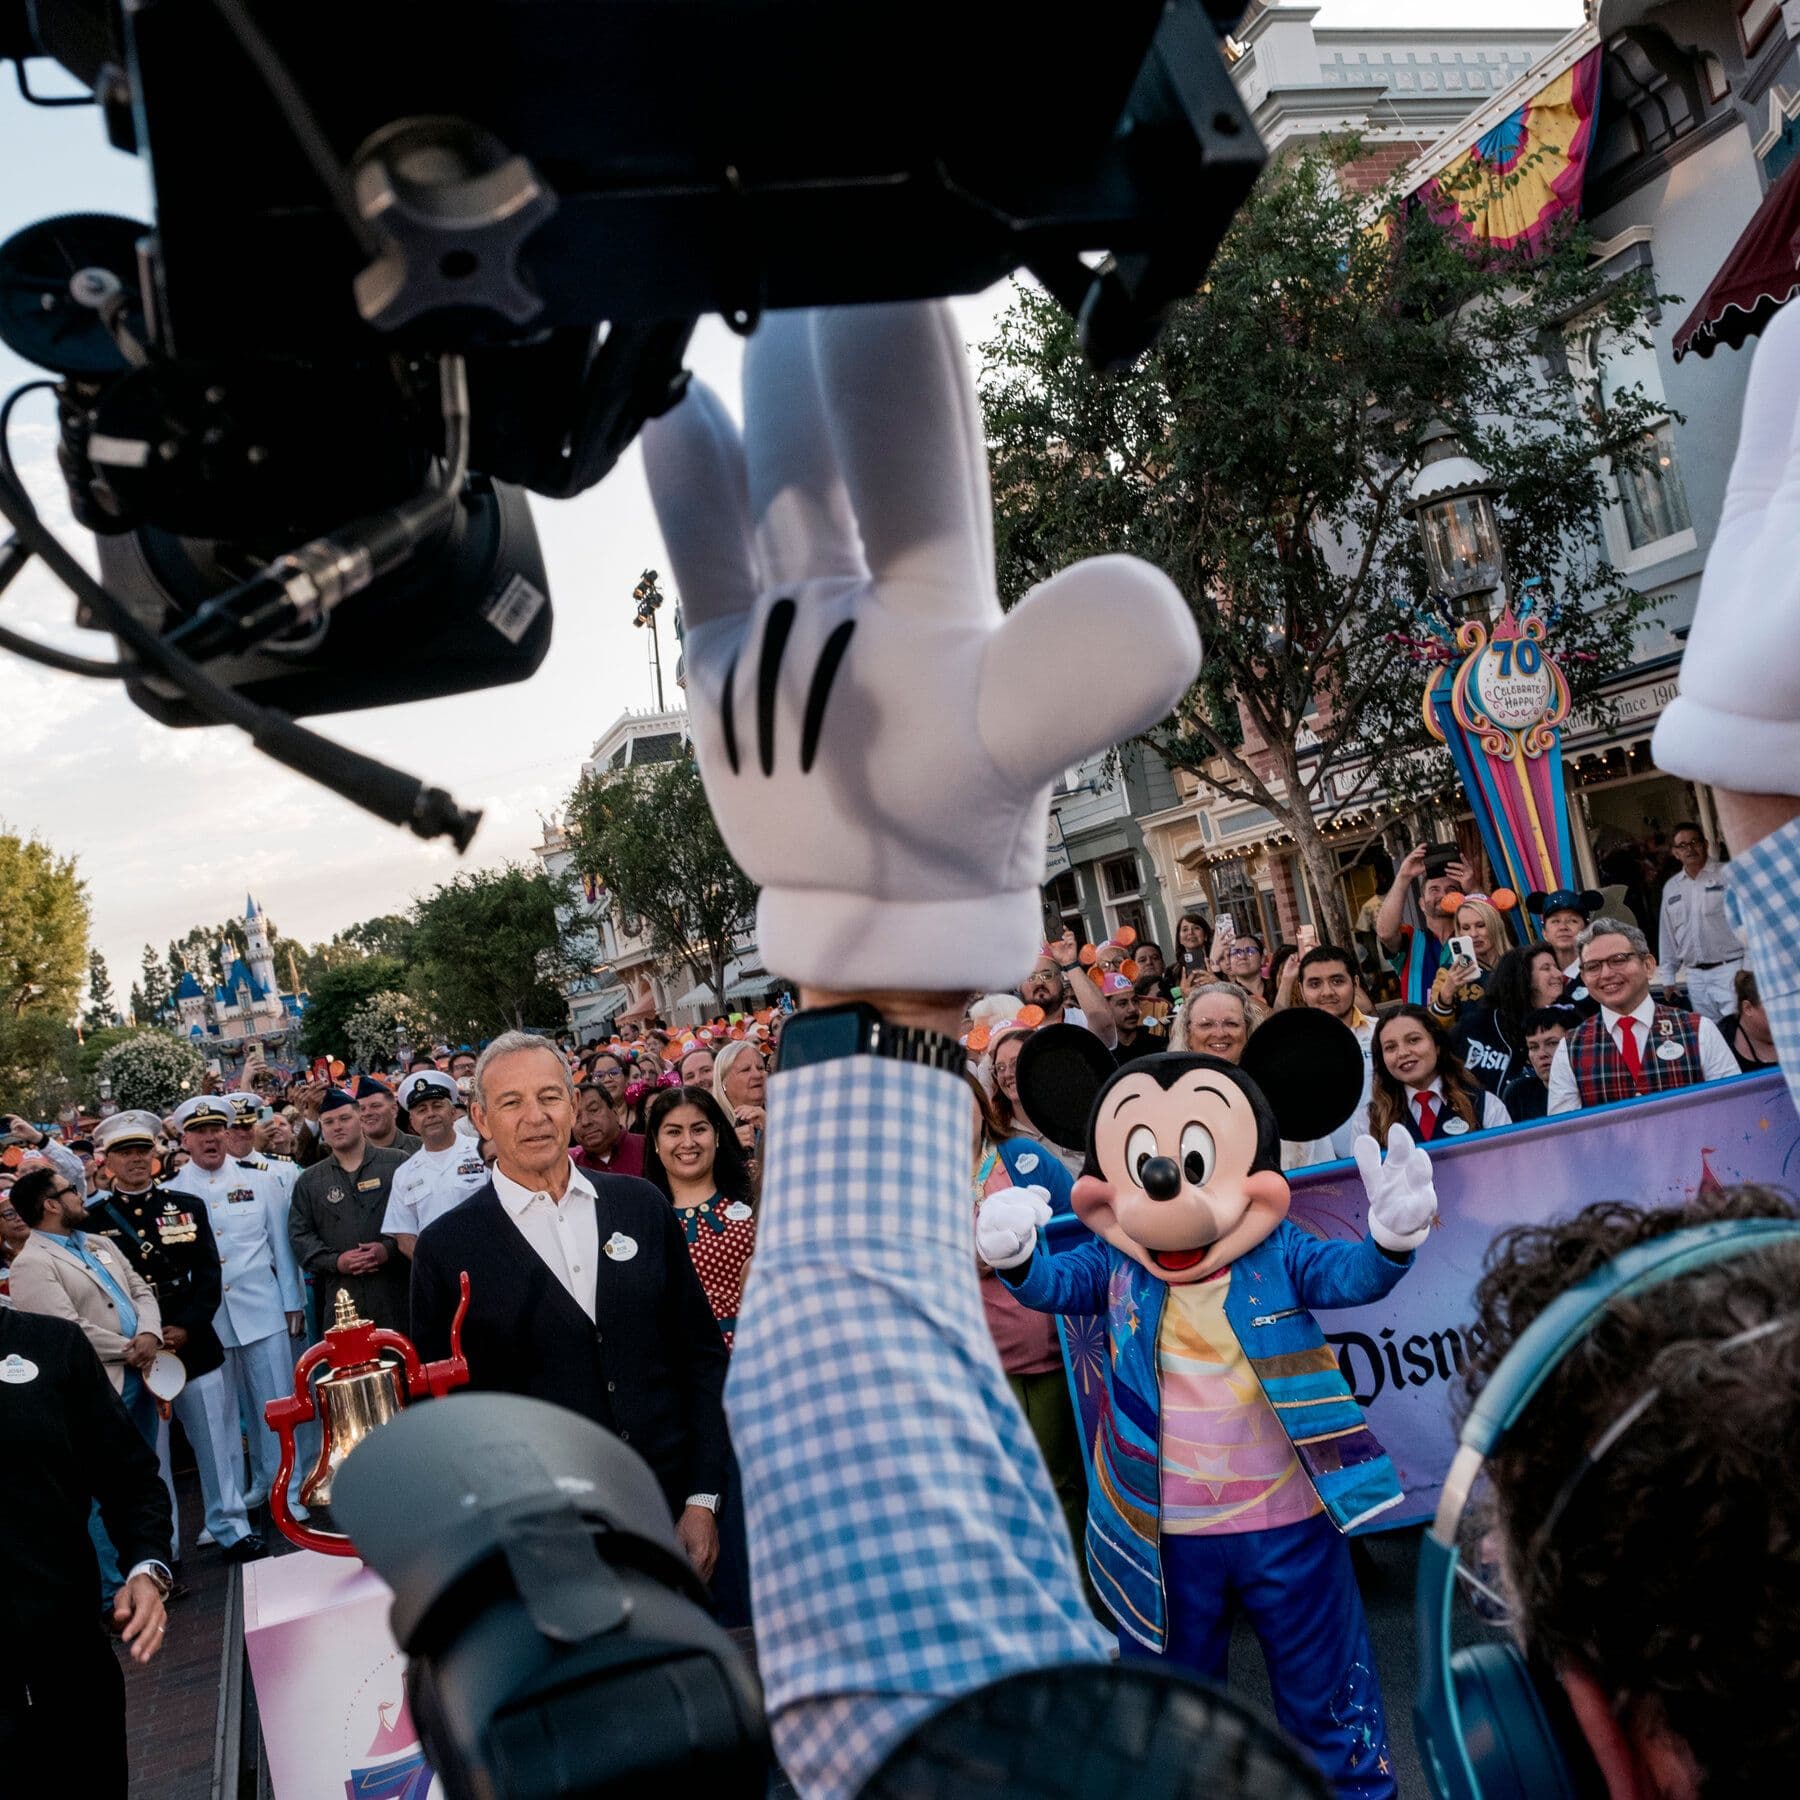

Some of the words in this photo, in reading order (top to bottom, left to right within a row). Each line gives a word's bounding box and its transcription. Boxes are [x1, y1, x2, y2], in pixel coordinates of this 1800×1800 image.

[1490, 639, 1541, 677] 70
[1611, 695, 1648, 717] Since
[1652, 682, 1682, 708] 190
